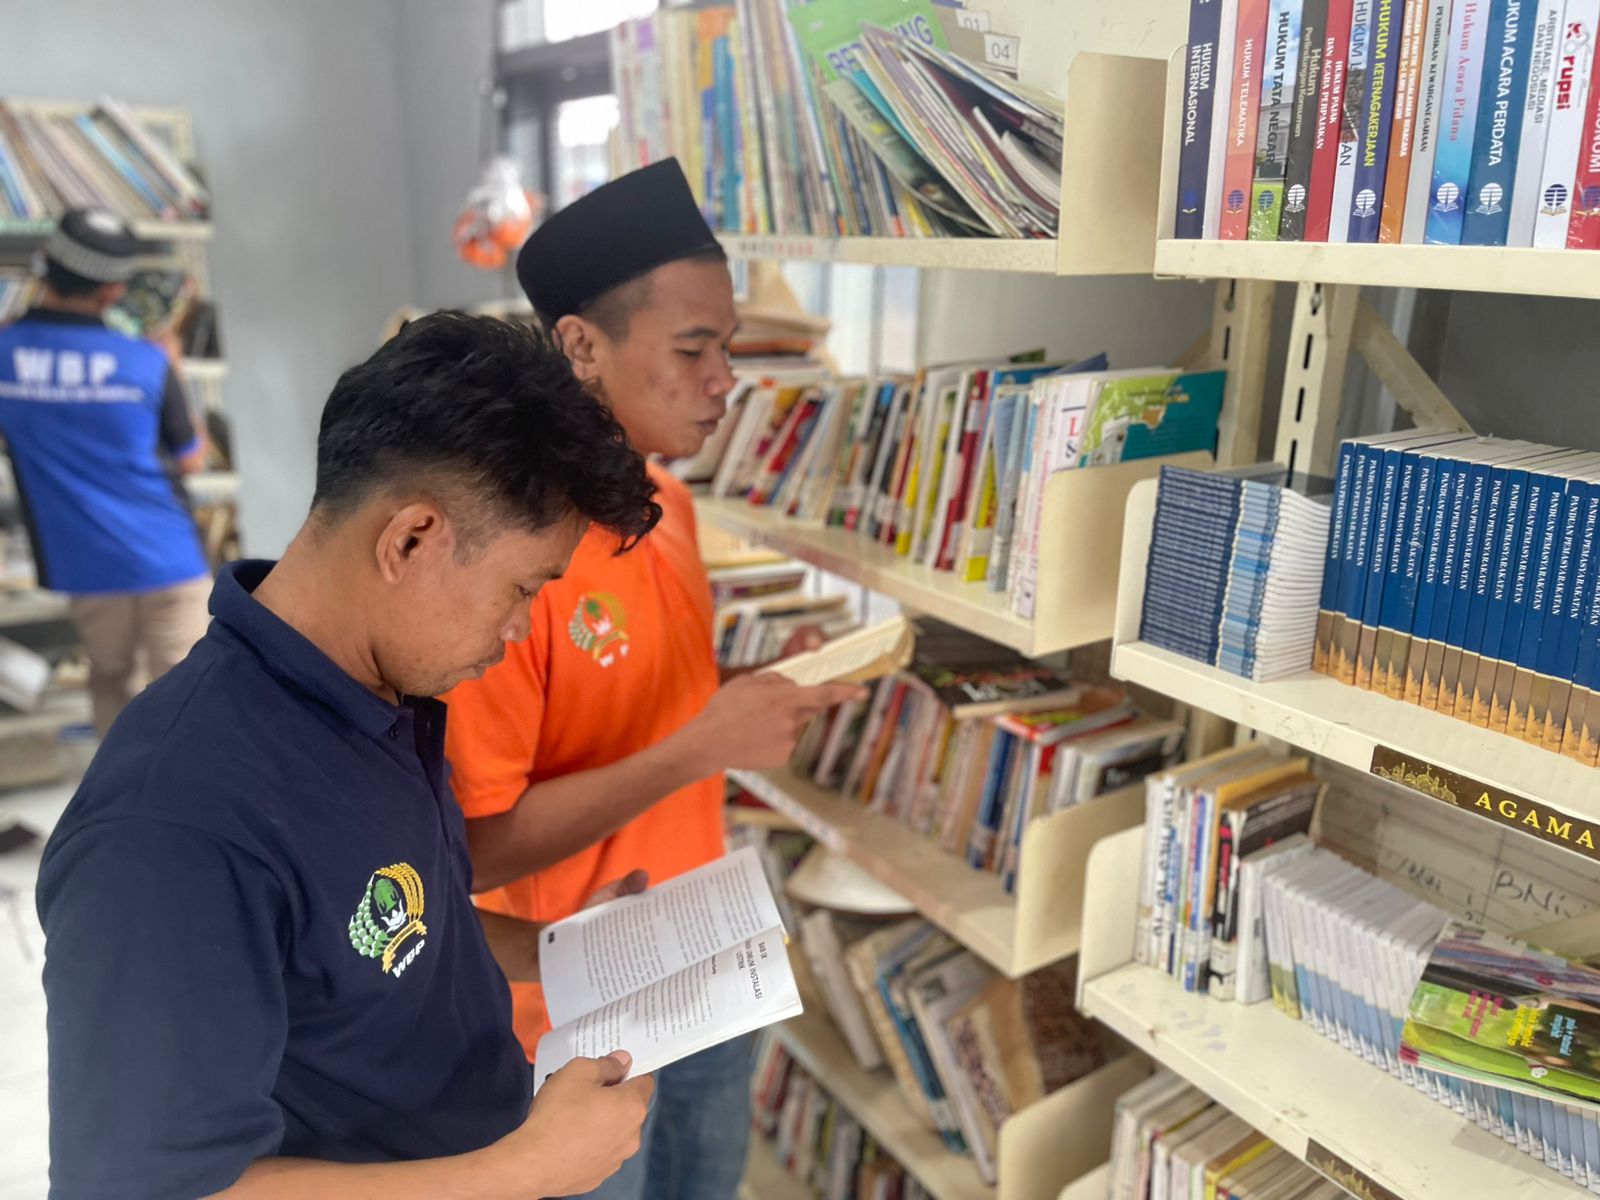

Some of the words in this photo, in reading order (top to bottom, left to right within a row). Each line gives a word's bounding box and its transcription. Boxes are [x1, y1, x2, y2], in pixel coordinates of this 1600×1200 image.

[1274, 11, 1290, 71] HUKUM
[1352, 2, 1369, 57] HUKUM
[1375, 0, 1392, 59] HUKUM
[1430, 6, 1443, 61] PENDIDIKAN
[1459, 3, 1477, 48] Hukum
[1503, 0, 1521, 44] UKUM
[1534, 24, 1546, 53] DAN
[1542, 10, 1558, 75] ARBITRASE,
[991, 42, 1010, 60] 04
[1199, 42, 1213, 90] HUKUM
[1242, 38, 1254, 80] HUKUM
[1299, 27, 1313, 88] Perlindungan
[1325, 37, 1336, 56] DAN
[1184, 45, 1202, 146] INTERNASIONAL
[1270, 72, 1284, 108] TATA
[1306, 48, 1322, 96] Hukum
[1321, 58, 1332, 90] ACARA
[1332, 60, 1344, 93] HUKUM
[1455, 56, 1470, 93] Acara
[1496, 46, 1515, 97] ACARA
[1527, 54, 1542, 111] NEGOSIASI
[1236, 81, 1250, 147] TELEMATIKA
[1294, 88, 1306, 137] Konsumen
[1315, 91, 1329, 150] PERPAJAKAN
[1328, 96, 1339, 124] PAJAK
[1363, 62, 1385, 167] KETENAGAKERJAAN
[1420, 64, 1437, 152] KEWARGANEGARAAN
[1449, 97, 1466, 142] Pidana
[1534, 79, 1548, 124] MEDIASI
[1488, 99, 1509, 167] PERDATA
[13, 346, 117, 386] WBP
[1365, 459, 1377, 496] PANDUAN
[1383, 465, 1395, 501] PANDUAN
[1401, 464, 1413, 502] PANDUAN
[1418, 467, 1430, 505] PANDUAN
[1437, 472, 1450, 510] PANDUAN
[1454, 472, 1466, 510] PANDUAN
[1471, 476, 1484, 514] PANDUAN
[1489, 479, 1502, 519] PANDUAN
[1507, 484, 1521, 523] PANDUAN
[1526, 486, 1540, 526] PANDUAN
[1545, 491, 1561, 531] PANDUAN
[1565, 495, 1580, 536] PANDUAN
[1583, 497, 1600, 538] PANDUAN
[1357, 497, 1372, 566] PEMASYARAKATAN
[1373, 502, 1389, 573] PEMASYARAKATAN
[1390, 502, 1407, 574] PEMASYARAKATAN
[1426, 511, 1444, 583] PEMASYARAKATAN
[1442, 511, 1460, 585] PEMASYARAKATAN
[1459, 515, 1477, 590] PEMASYARAKATAN
[1477, 520, 1495, 595] PEMASYARAKATAN
[1495, 524, 1514, 600] PEMASYARAKATAN
[1513, 527, 1533, 604] PEMASYARAKATAN
[1532, 532, 1553, 610] PEMASYARAKATAN
[1551, 537, 1573, 615] PEMASYARAKATAN
[1570, 539, 1592, 619] PEMASYARAKATAN
[1474, 792, 1595, 849] AGAMA
[392, 939, 425, 978] WBP
[749, 967, 763, 1000] INSTALASI
